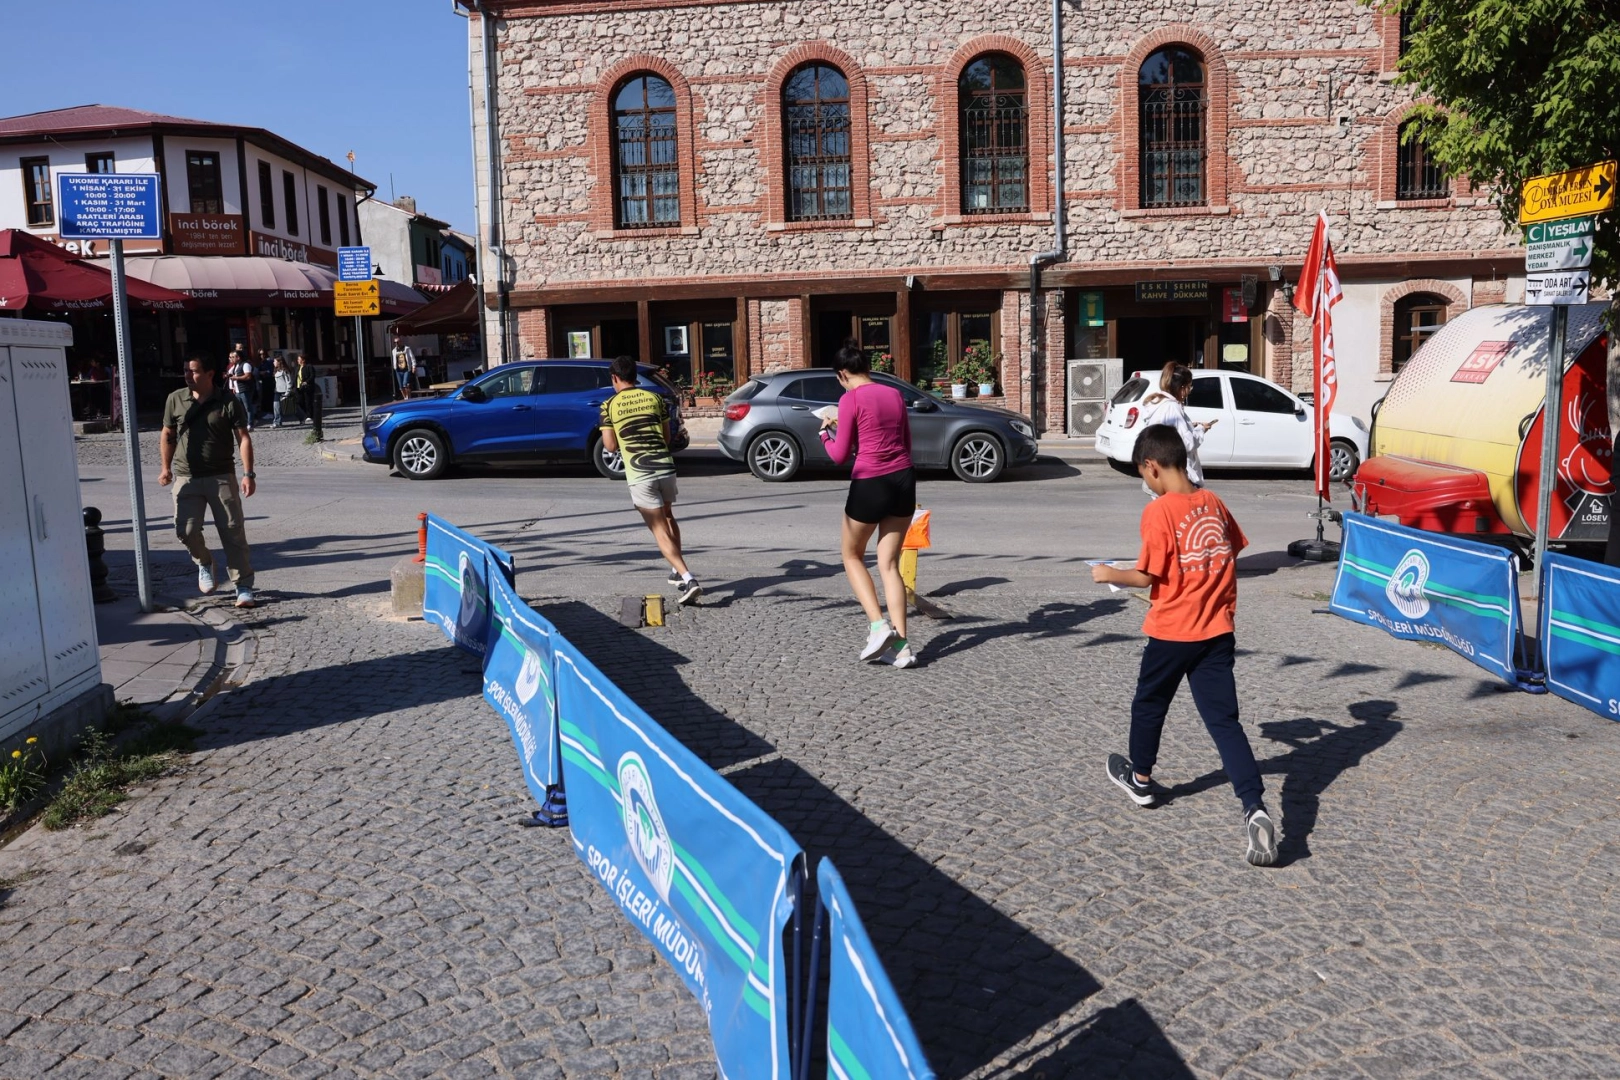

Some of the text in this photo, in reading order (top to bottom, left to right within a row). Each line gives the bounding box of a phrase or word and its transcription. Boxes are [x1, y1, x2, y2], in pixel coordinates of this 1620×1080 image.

[125, 184, 146, 192] EKİM
[1540, 196, 1558, 210] OYA
[178, 219, 238, 230] inci börek
[1548, 221, 1591, 237] YEŞİLAY
[258, 235, 308, 264] inci börek
[1528, 240, 1571, 252] DANIŞMANLIK
[1528, 252, 1556, 260] MERKEZİ
[1527, 262, 1549, 270] YEDAM
[1174, 282, 1208, 291] ŞEHRİN
[1544, 277, 1573, 288] ODA ART
[192, 290, 218, 298] börek
[621, 392, 645, 400] South
[616, 396, 654, 408] Yorkshire
[617, 404, 657, 416] Orienteers
[1581, 513, 1608, 522] LÖSEV
[487, 680, 505, 705] SPOR
[587, 845, 618, 890] SPOR
[616, 869, 659, 928] İŞLERİ
